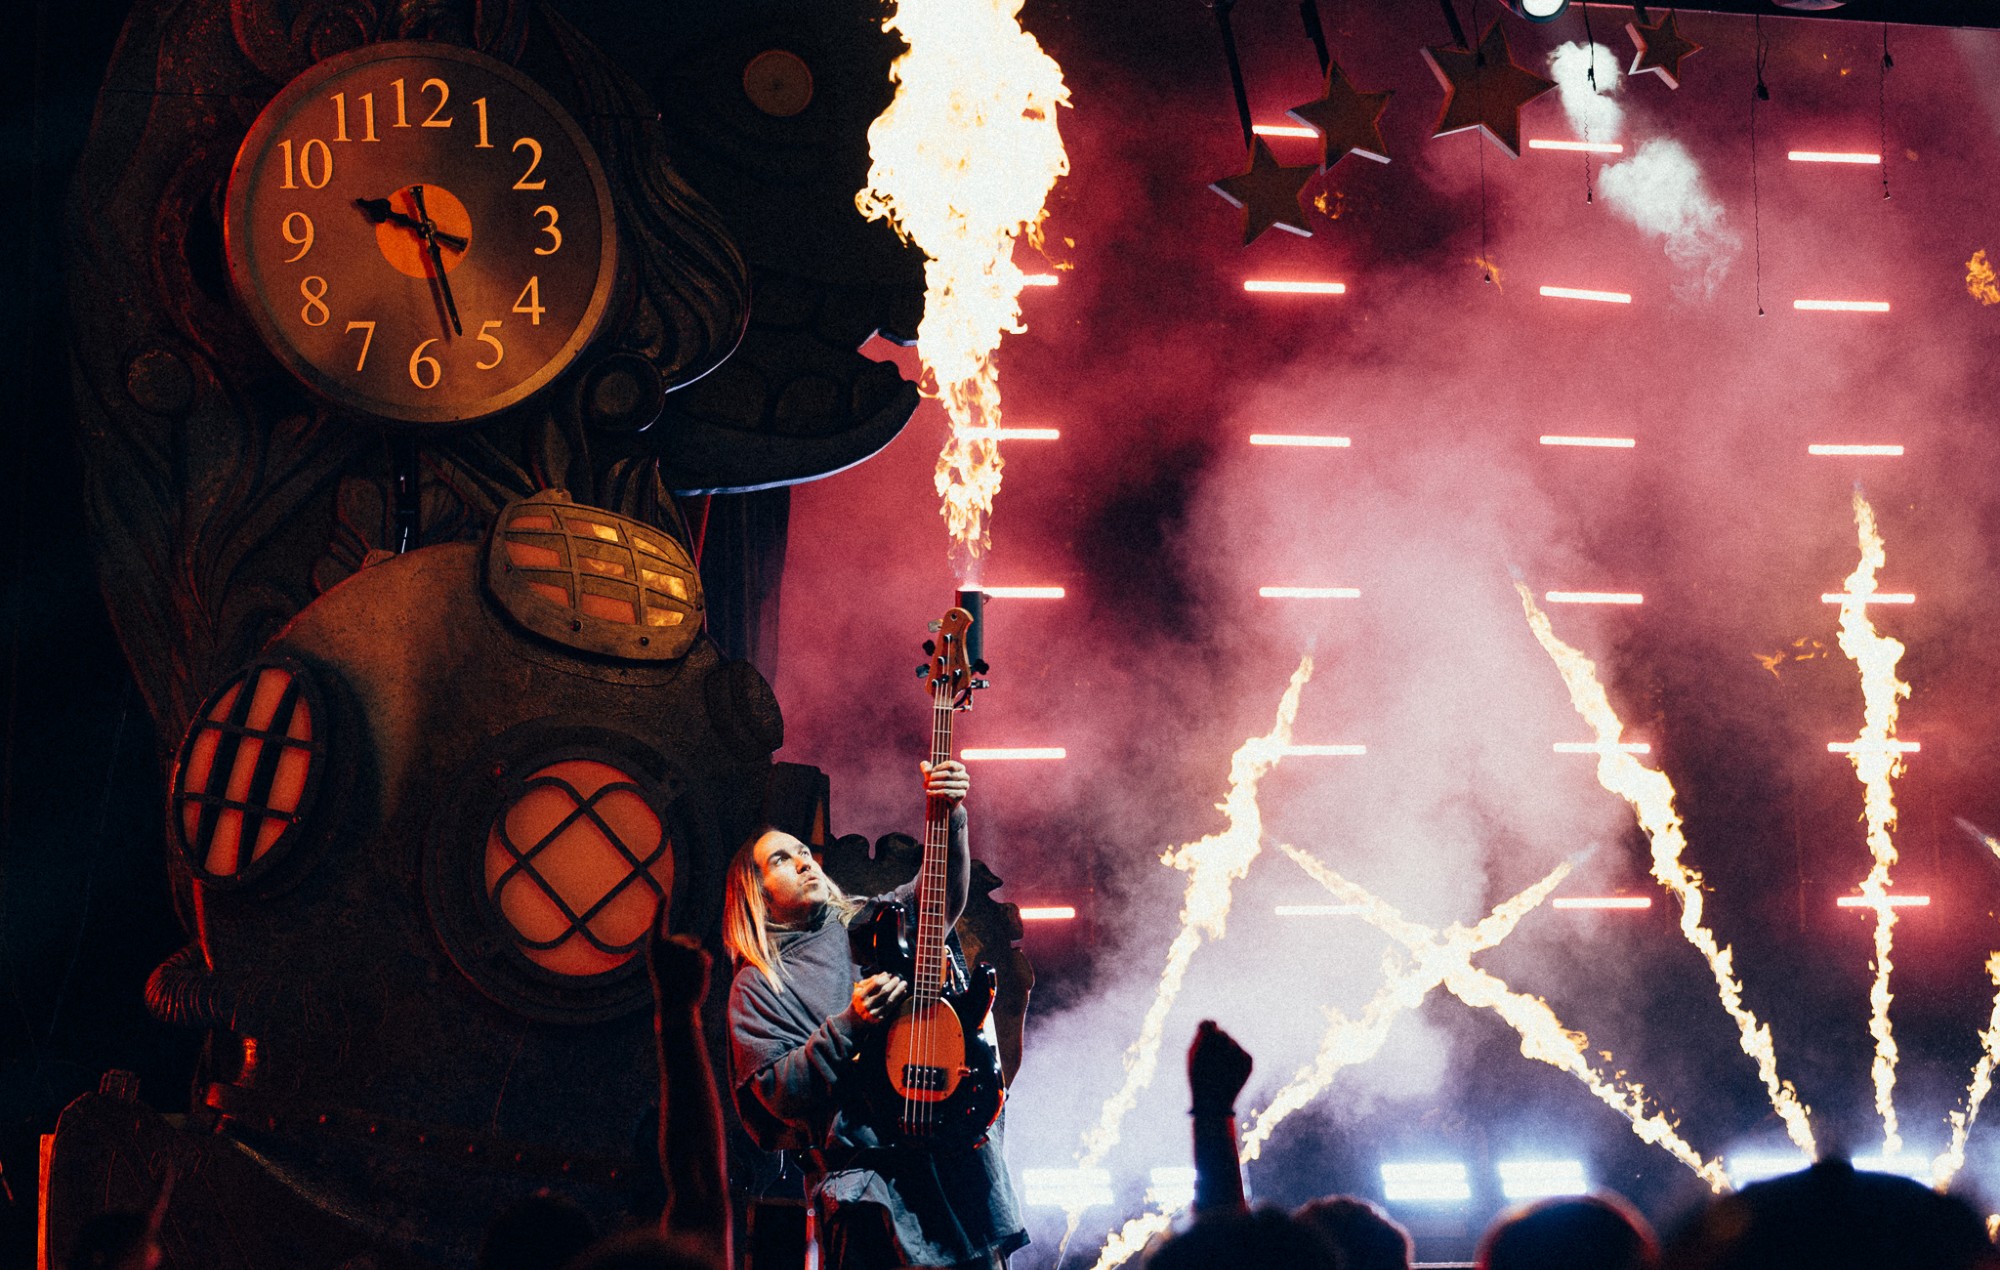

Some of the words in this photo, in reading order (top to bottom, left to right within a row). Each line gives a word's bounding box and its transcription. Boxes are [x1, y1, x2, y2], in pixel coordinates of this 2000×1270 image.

[330, 92, 381, 142] 11
[390, 77, 454, 128] 12
[472, 97, 494, 148] 1
[278, 138, 333, 190] 10
[511, 137, 547, 191] 2
[282, 211, 315, 263] 9
[533, 204, 563, 256] 3
[300, 275, 331, 327] 8
[512, 275, 546, 326] 4
[344, 321, 376, 372] 7
[408, 338, 442, 389] 6
[475, 320, 504, 370] 5
